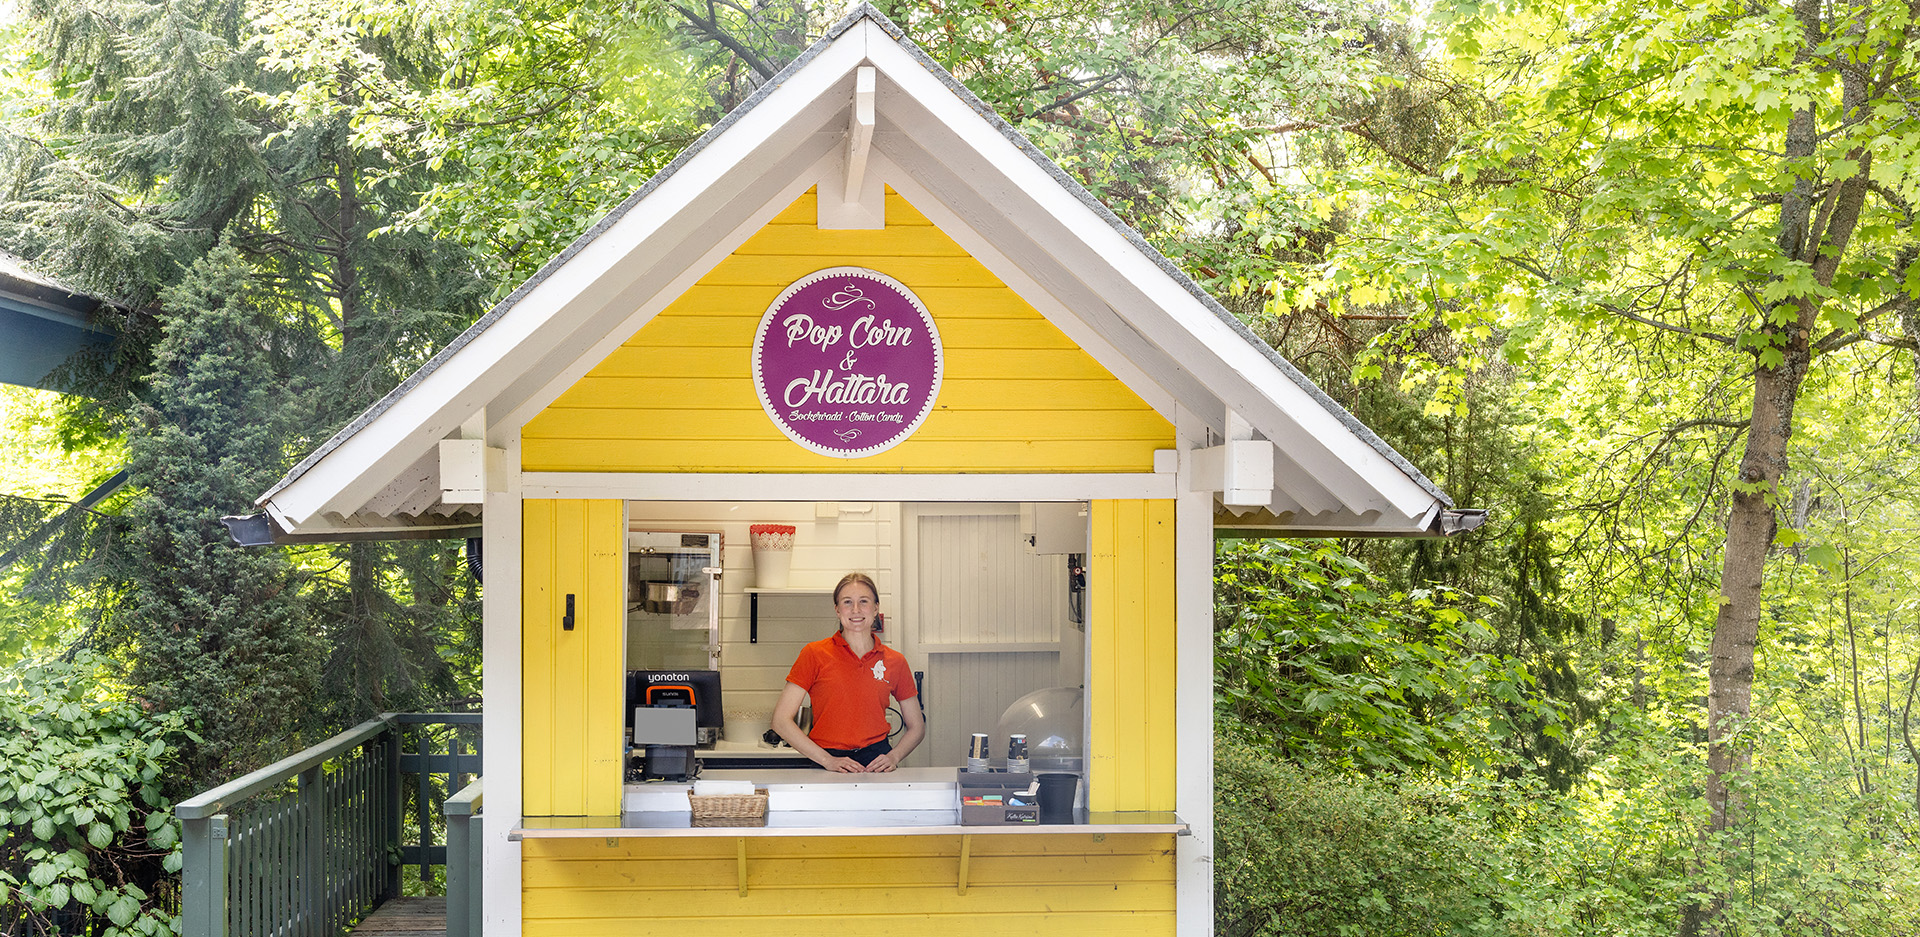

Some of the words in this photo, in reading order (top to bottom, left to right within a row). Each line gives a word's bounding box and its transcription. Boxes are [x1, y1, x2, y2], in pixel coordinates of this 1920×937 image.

[782, 313, 844, 353] Pop
[849, 314, 913, 350] Corn
[839, 350, 858, 371] &
[783, 369, 911, 408] Hattara
[788, 409, 844, 422] Sockervadd
[848, 410, 876, 423] Cotton
[876, 411, 904, 424] Candy
[647, 673, 690, 683] yonoton
